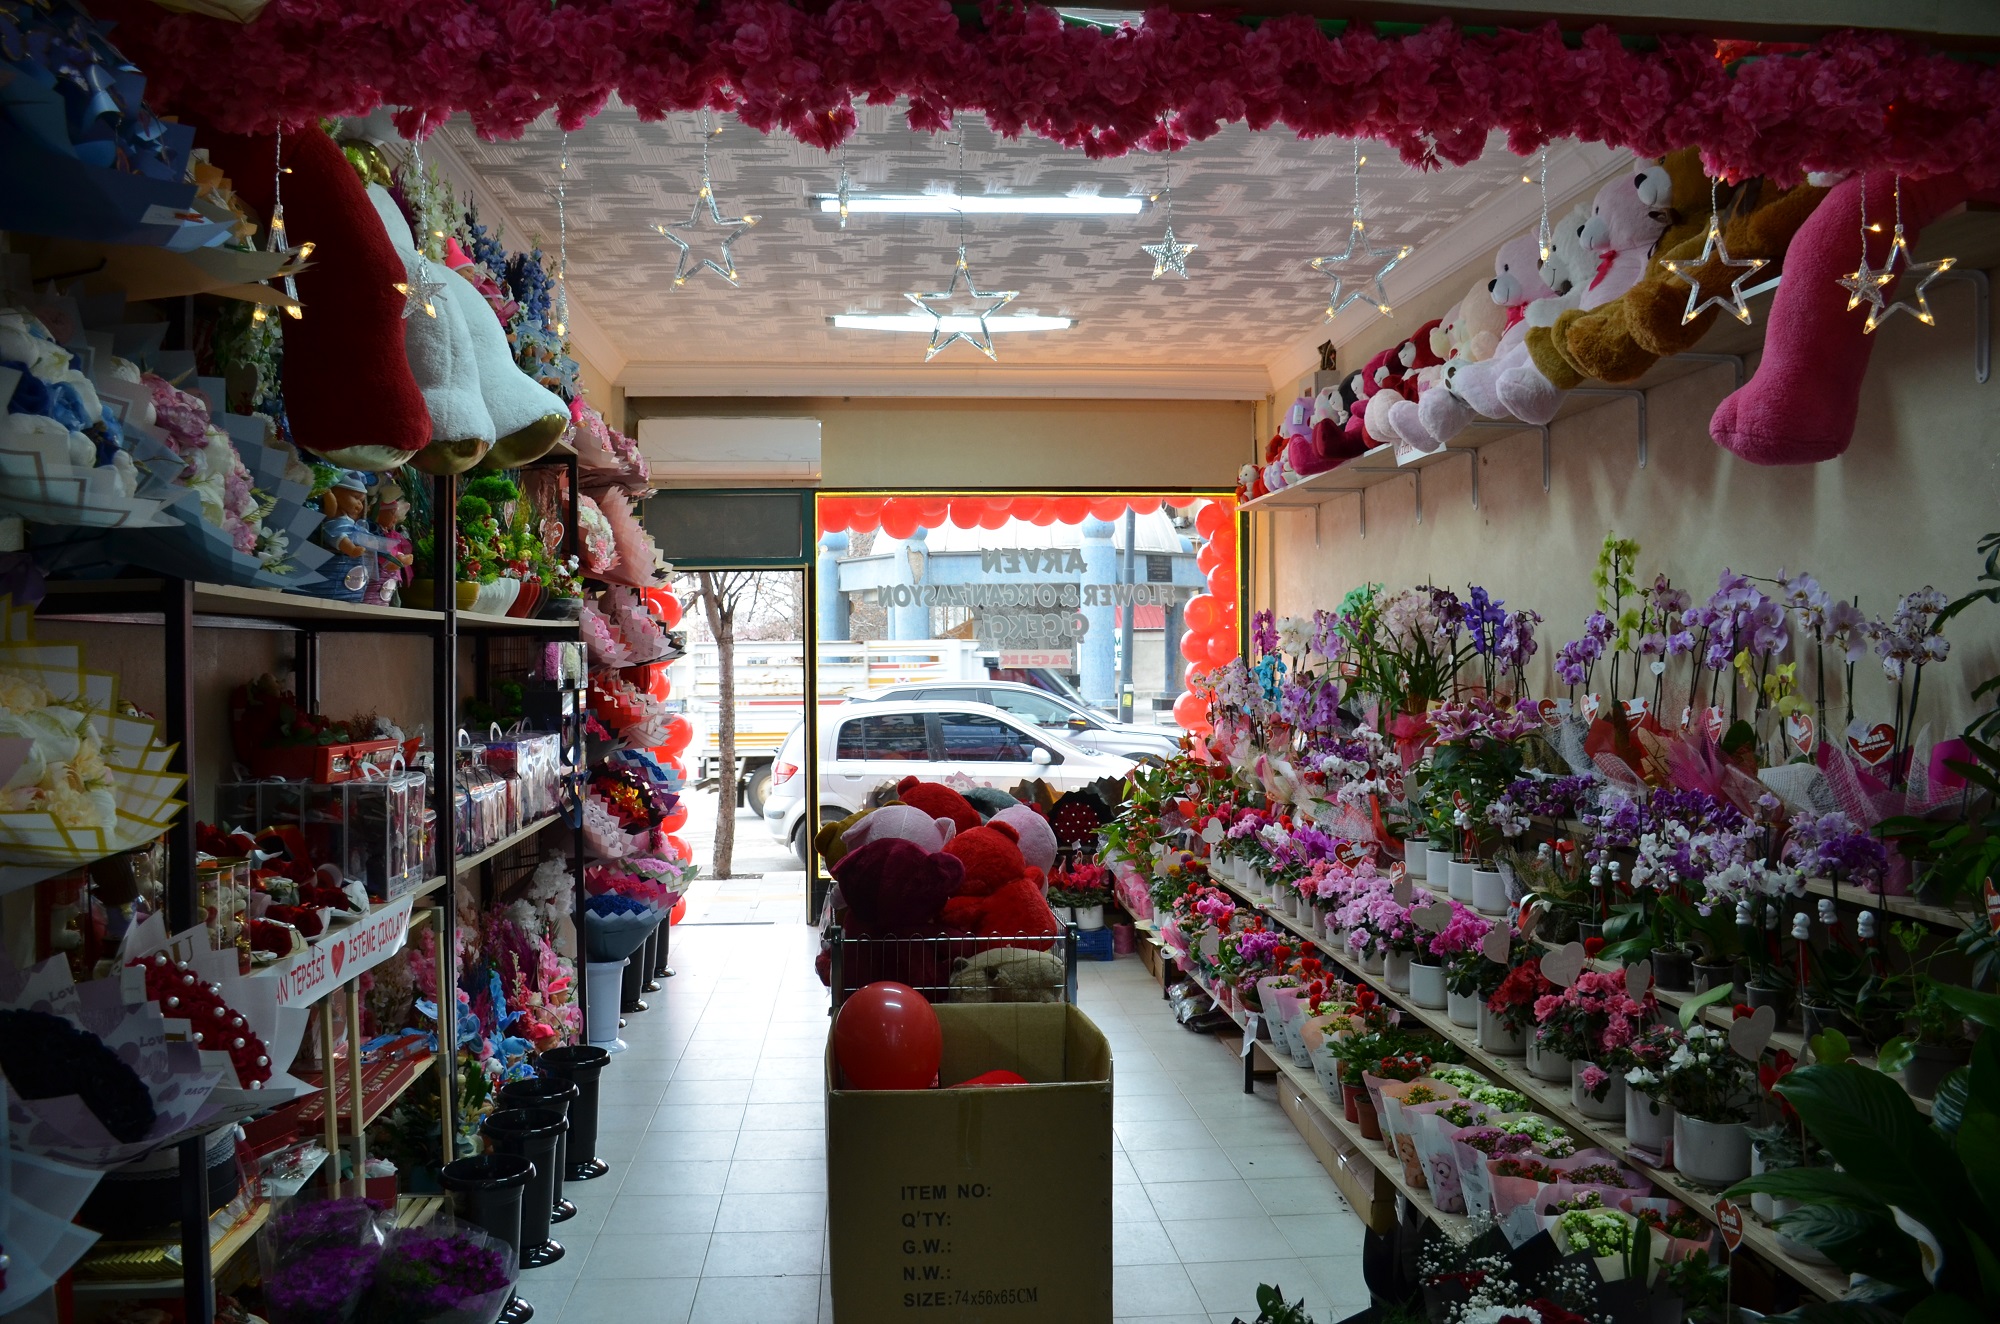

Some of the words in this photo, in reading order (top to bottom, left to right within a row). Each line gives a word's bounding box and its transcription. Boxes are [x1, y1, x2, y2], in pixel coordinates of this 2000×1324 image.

[348, 925, 376, 964] İSTEME
[901, 1184, 947, 1201] ITEM
[957, 1182, 992, 1199] NO:
[901, 1210, 951, 1228] Q'TY:
[902, 1239, 952, 1255] G.W.:
[903, 1266, 952, 1281] N.W.:
